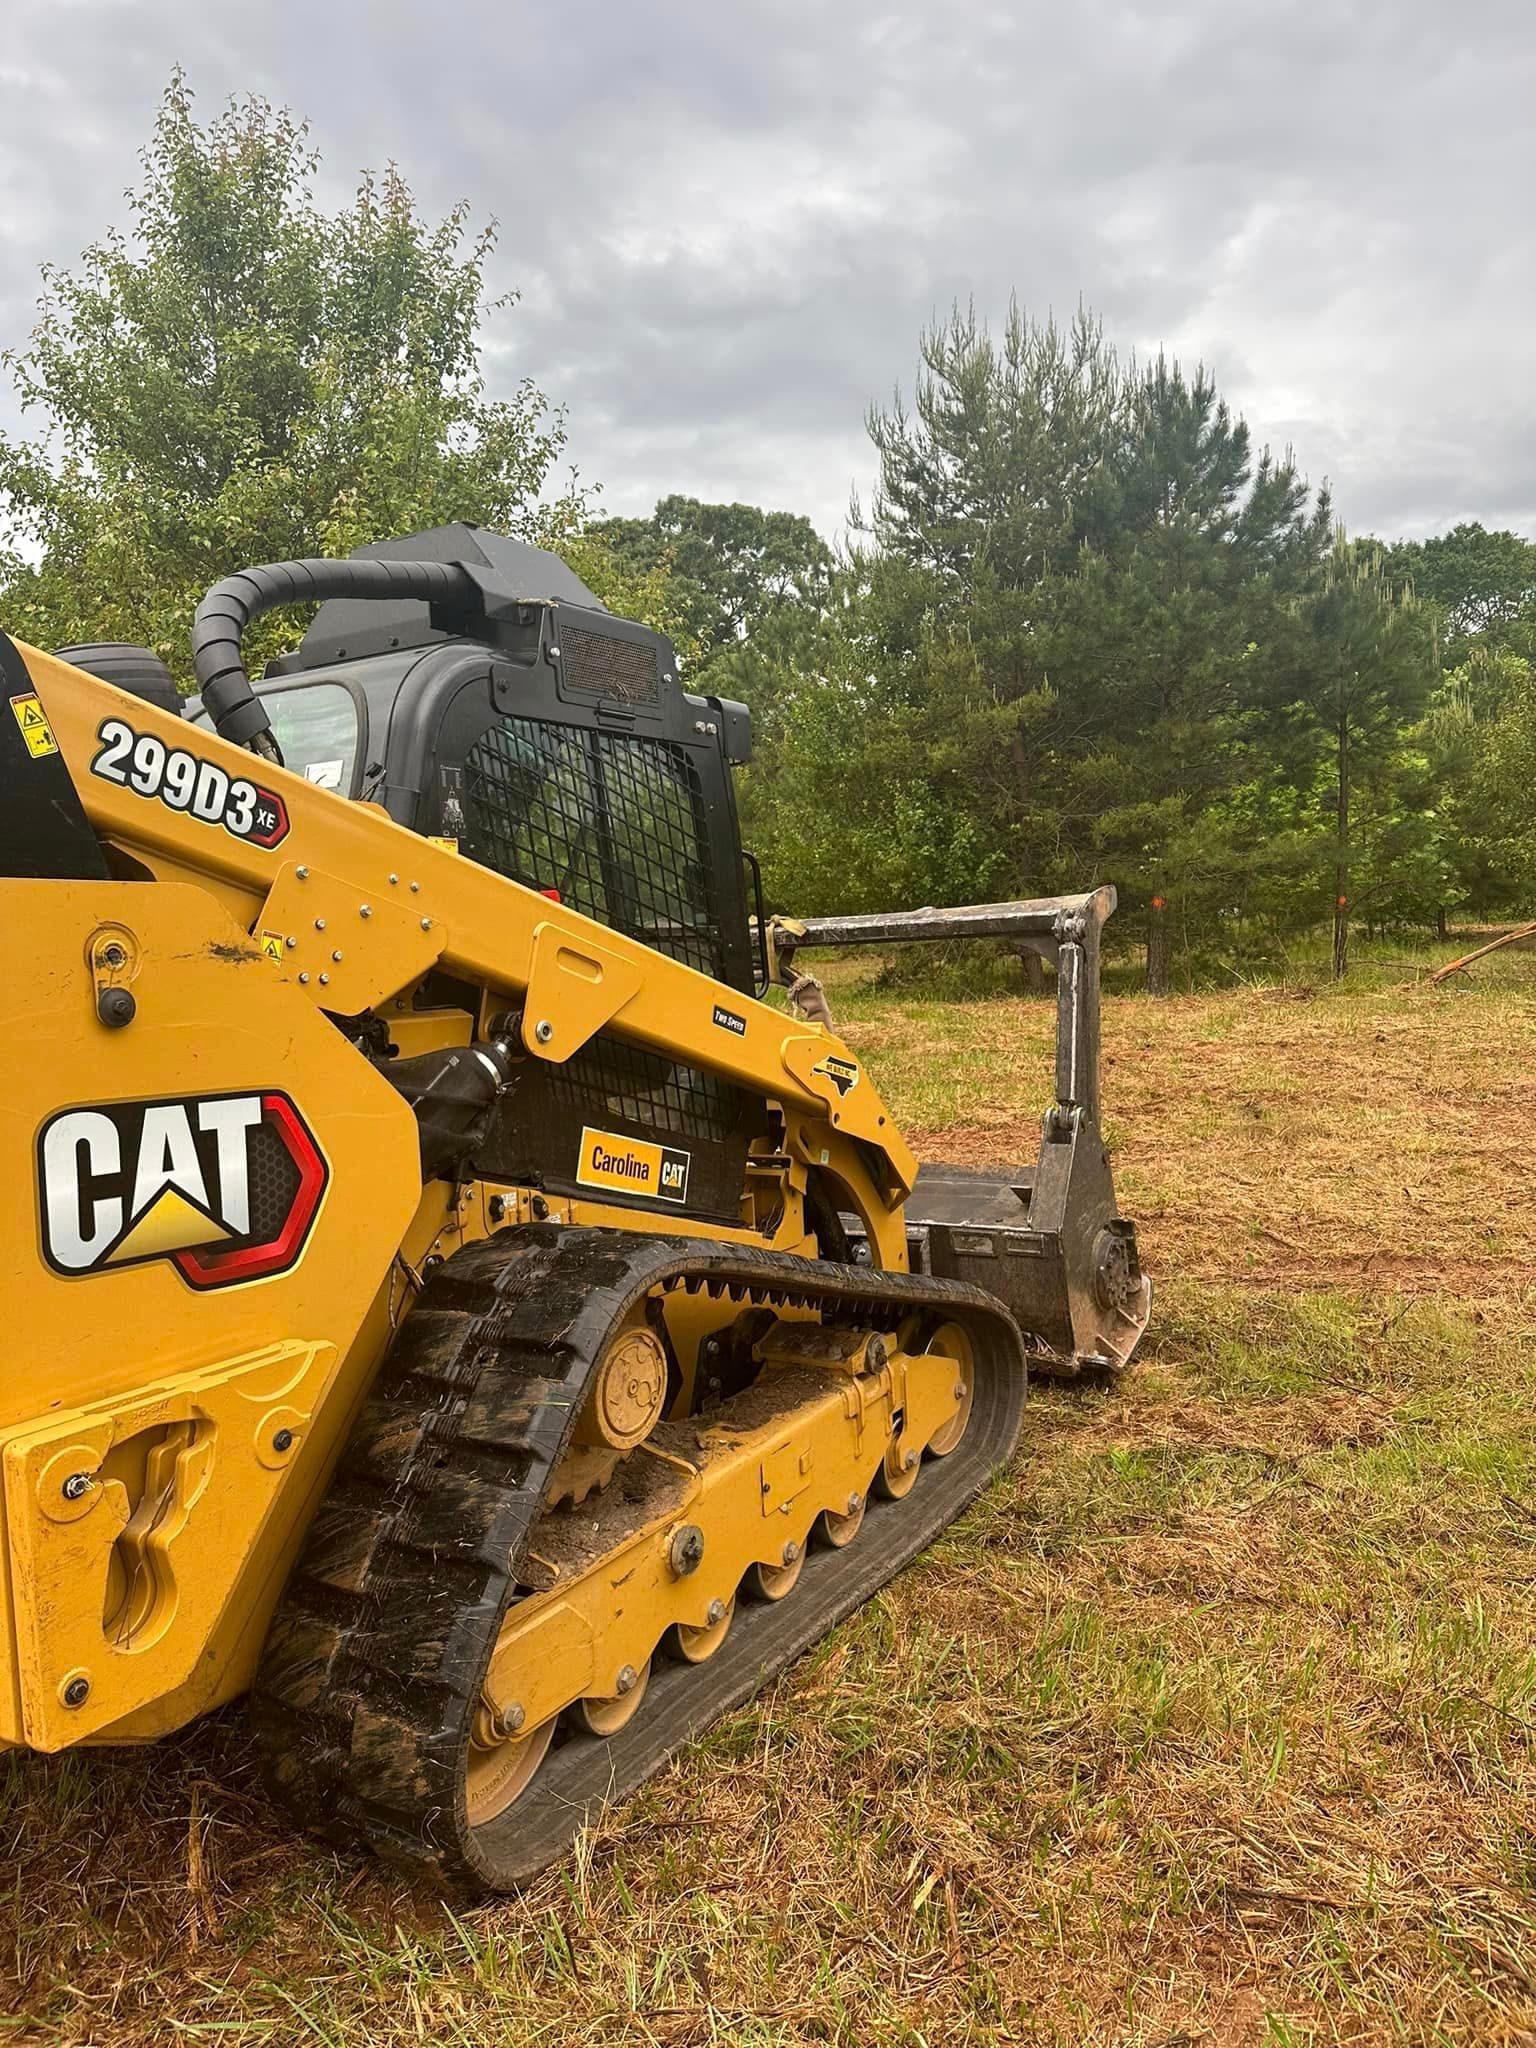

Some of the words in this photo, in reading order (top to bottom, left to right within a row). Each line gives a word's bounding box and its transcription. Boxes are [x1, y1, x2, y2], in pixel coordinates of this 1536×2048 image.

[94, 721, 257, 834] 299D3
[256, 808, 276, 830] XE
[44, 1096, 262, 1269] CAT
[592, 1146, 650, 1181] Carolina
[662, 1161, 686, 1188] CAT
